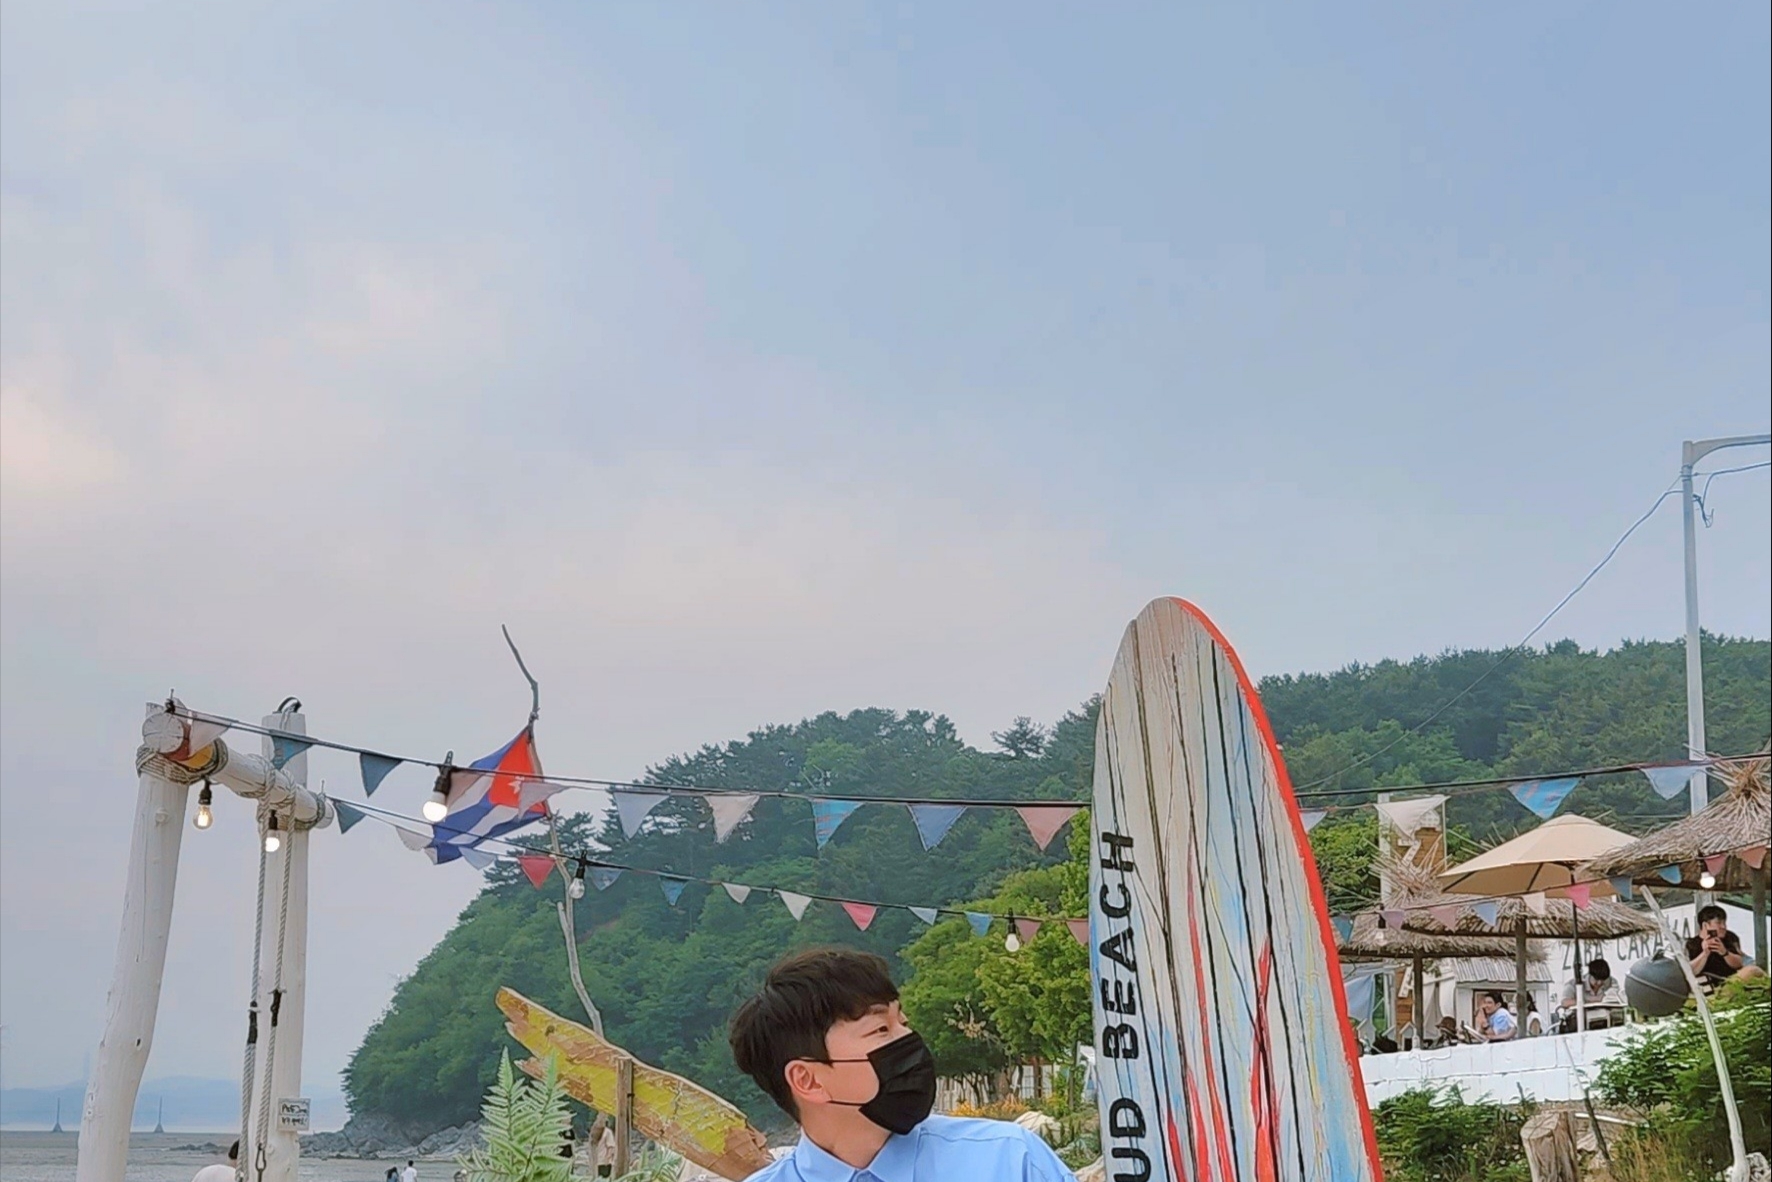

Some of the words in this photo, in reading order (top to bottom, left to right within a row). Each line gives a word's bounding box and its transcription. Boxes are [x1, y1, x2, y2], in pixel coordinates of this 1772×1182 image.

[1100, 832, 1139, 1060] BEACH
[1562, 940, 1605, 970] ZBA
[1616, 914, 1698, 961] CARAVA
